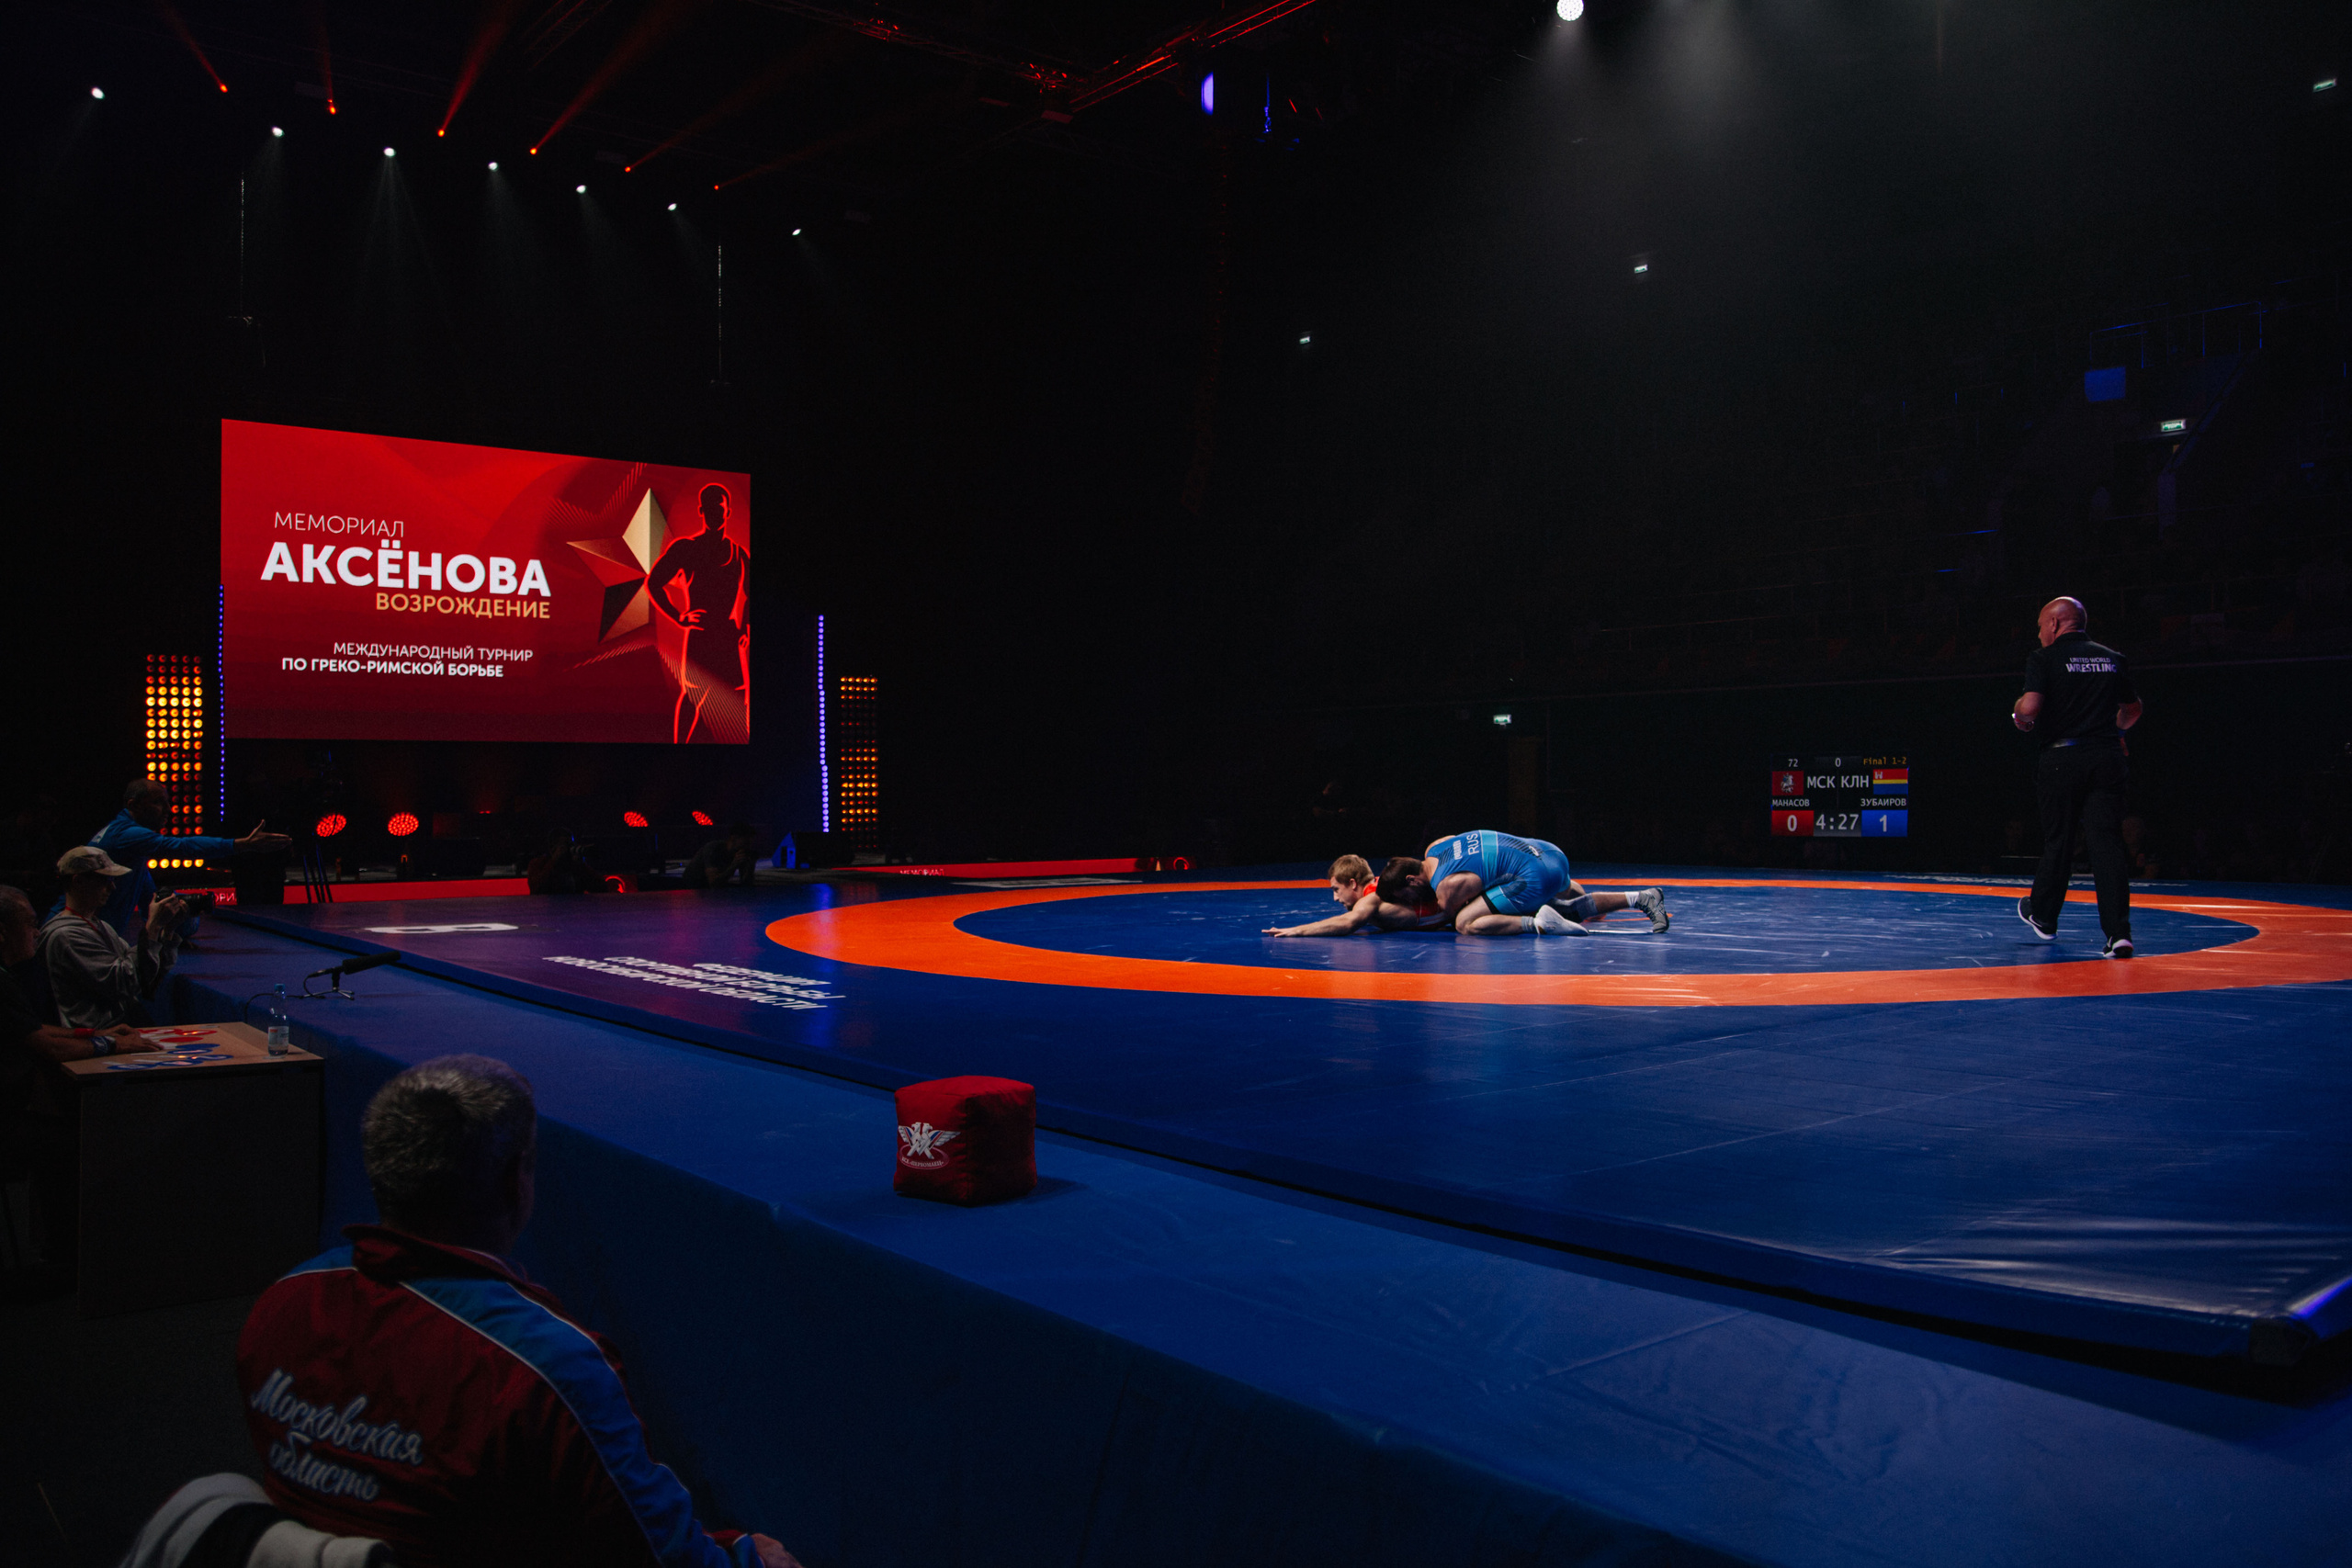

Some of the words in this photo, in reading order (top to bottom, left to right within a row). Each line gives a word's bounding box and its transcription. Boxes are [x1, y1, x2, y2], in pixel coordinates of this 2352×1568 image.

[274, 512, 404, 538] МЕМОРИАЛ
[261, 539, 551, 598] АКСЁНОВА
[376, 592, 550, 619] ВОЗРОЖДЕНИЕ
[334, 641, 473, 660] МЕЖДУНАРОДНЫЙ
[477, 647, 533, 662] ТУРНИР
[282, 658, 307, 671] ПО
[311, 658, 444, 677] ГРЕКО-РИМСКОЙ
[447, 662, 504, 678] БОРЬБЕ
[1788, 759, 1798, 767] 72
[1835, 758, 1841, 767] 0
[1863, 756, 1887, 765] Final
[1892, 756, 1907, 764] 1-2
[1806, 775, 1836, 788] МСК
[1840, 775, 1870, 788] КЛН
[1786, 814, 1798, 832] 0
[1815, 814, 1860, 830] 4:27
[1879, 814, 1888, 832] 1
[1466, 833, 1480, 855] RUS
[251, 1368, 424, 1467] Московская
[268, 1429, 381, 1502] область
